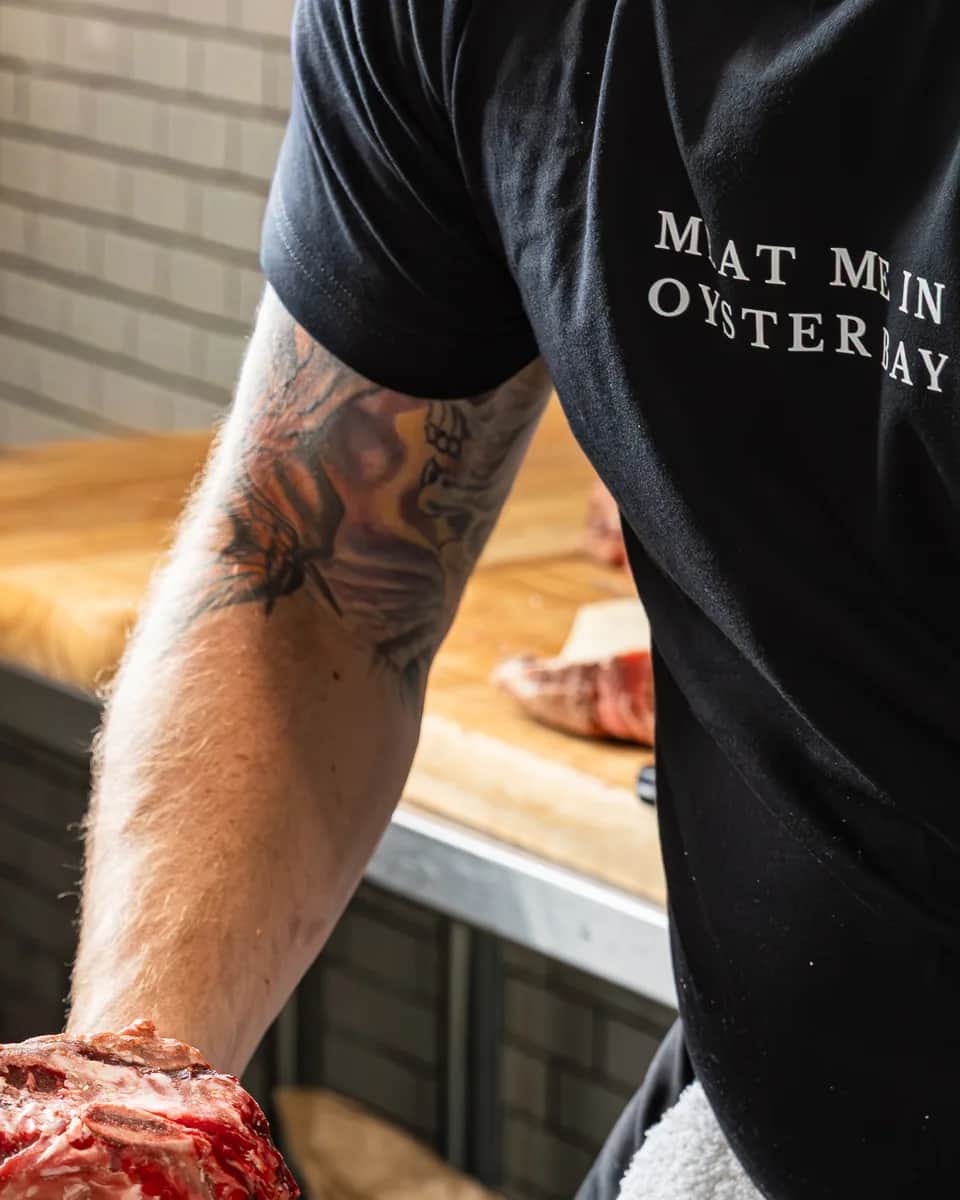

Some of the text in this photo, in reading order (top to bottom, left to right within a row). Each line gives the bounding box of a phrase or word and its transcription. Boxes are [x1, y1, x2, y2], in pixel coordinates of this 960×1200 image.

[654, 209, 946, 325] MAT ME IN
[647, 277, 949, 393] OYSTER BAY
